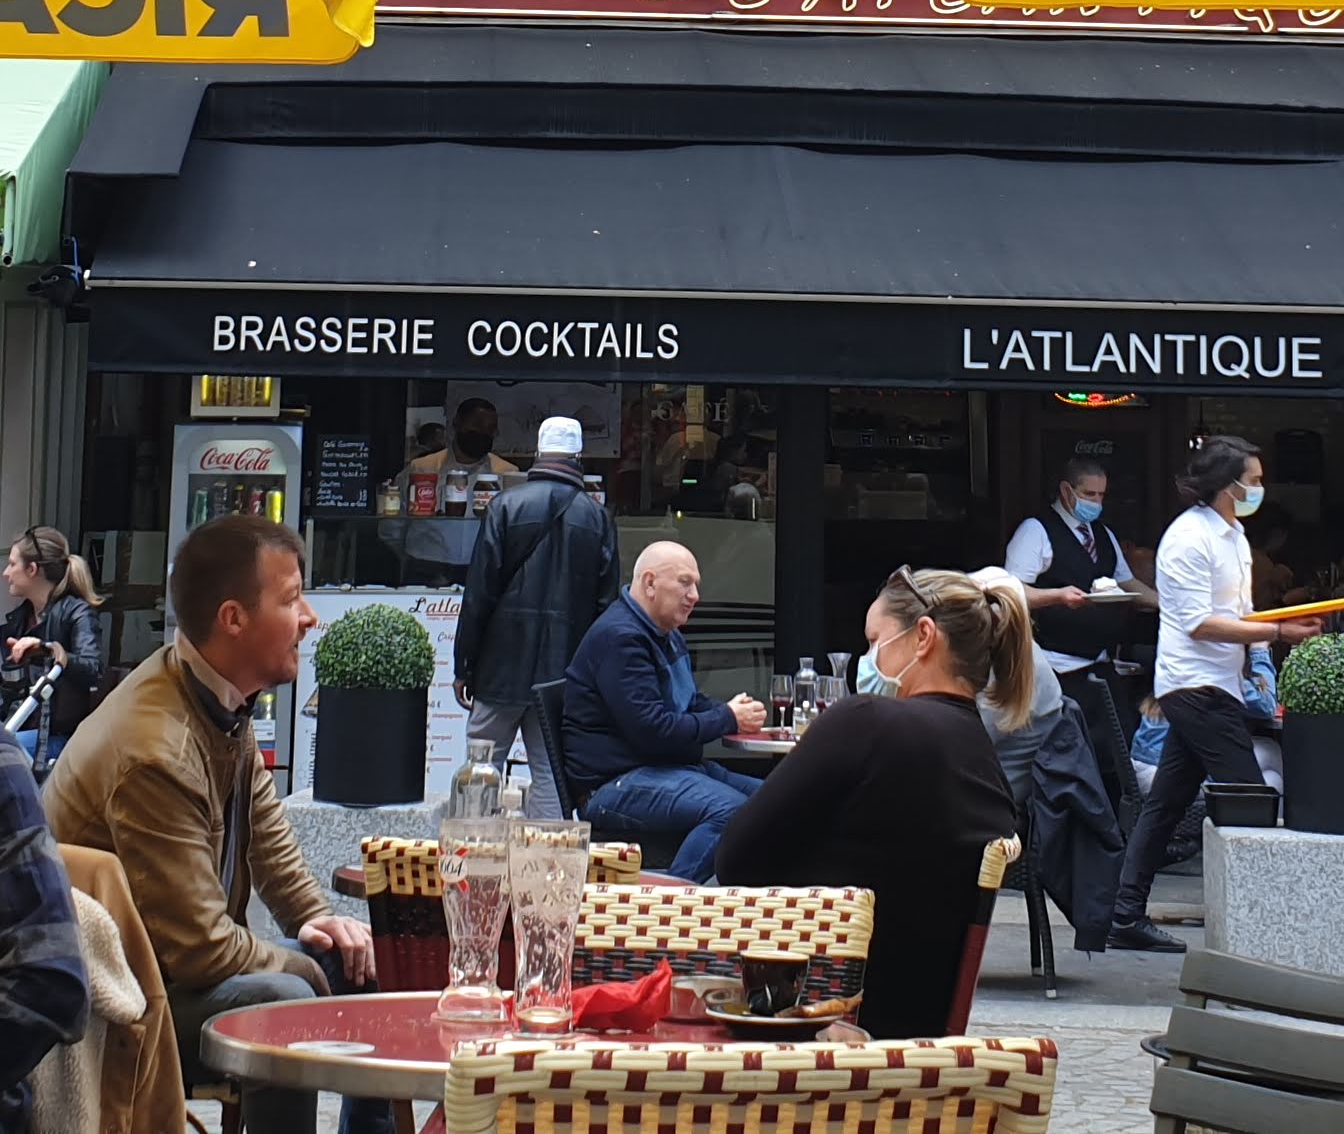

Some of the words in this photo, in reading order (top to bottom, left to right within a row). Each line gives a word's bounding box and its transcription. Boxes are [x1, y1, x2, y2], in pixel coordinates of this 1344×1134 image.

[212, 315, 435, 356] BRASSERIE
[467, 319, 679, 360] COCKTAILS
[962, 327, 1324, 380] L'ATLANTIQUE
[200, 447, 274, 471] Coca-Cola
[408, 596, 460, 614] L'atla
